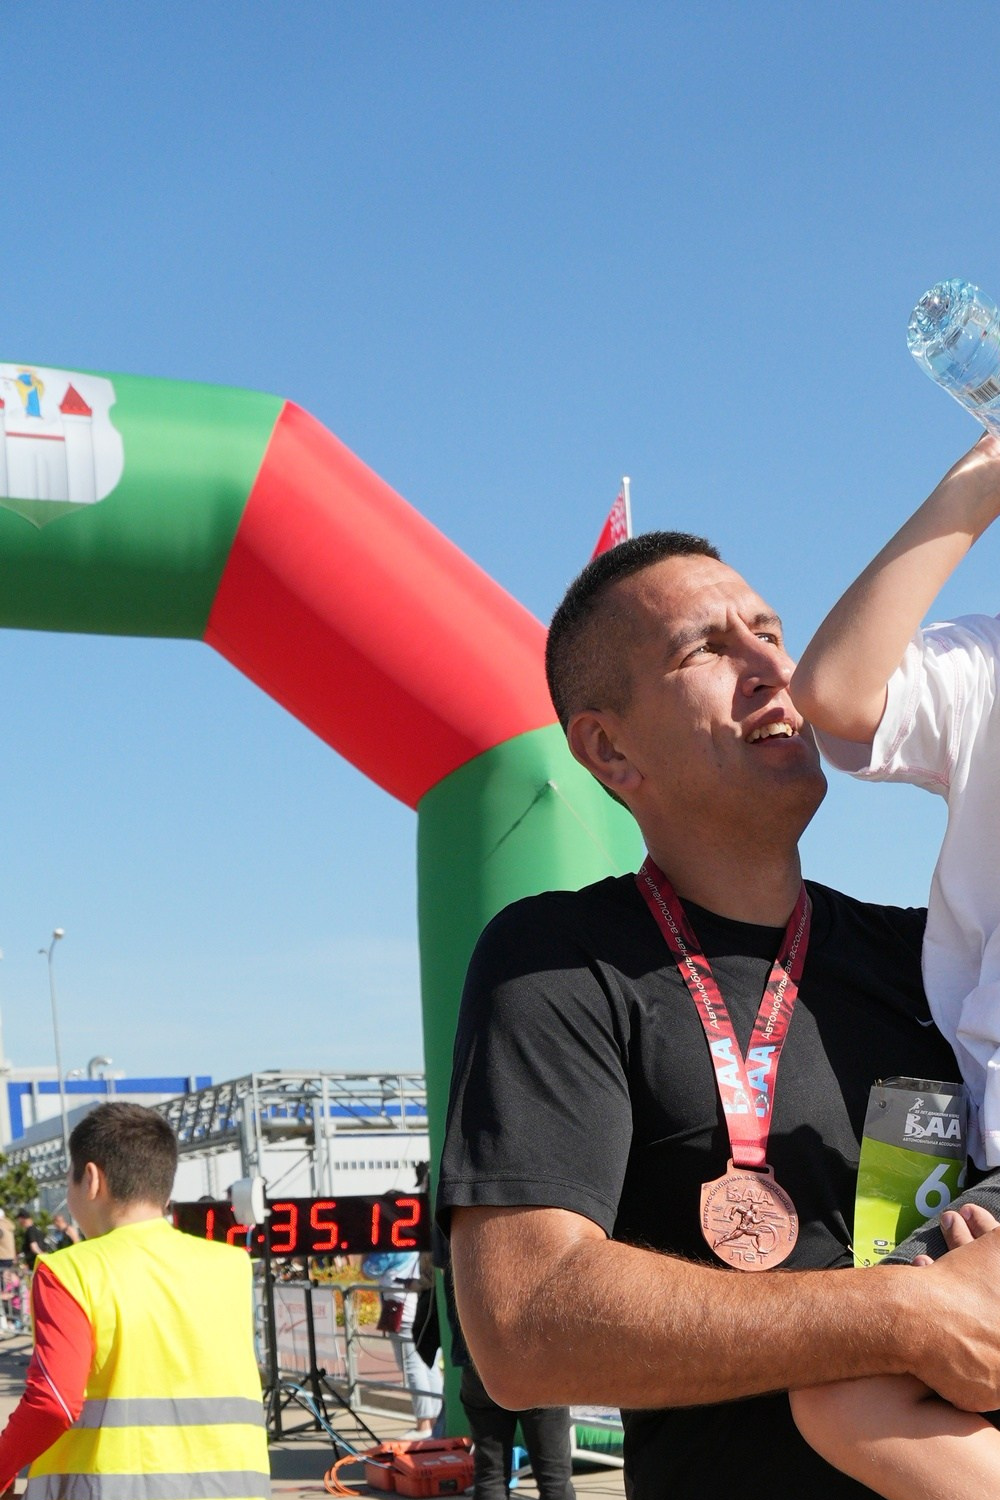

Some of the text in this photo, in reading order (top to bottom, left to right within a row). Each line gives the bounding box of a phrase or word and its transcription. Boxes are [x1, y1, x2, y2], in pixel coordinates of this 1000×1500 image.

[674, 936, 720, 1029] Автомобильная
[761, 960, 794, 1040] Автомобильная
[903, 1112, 961, 1140] БАА
